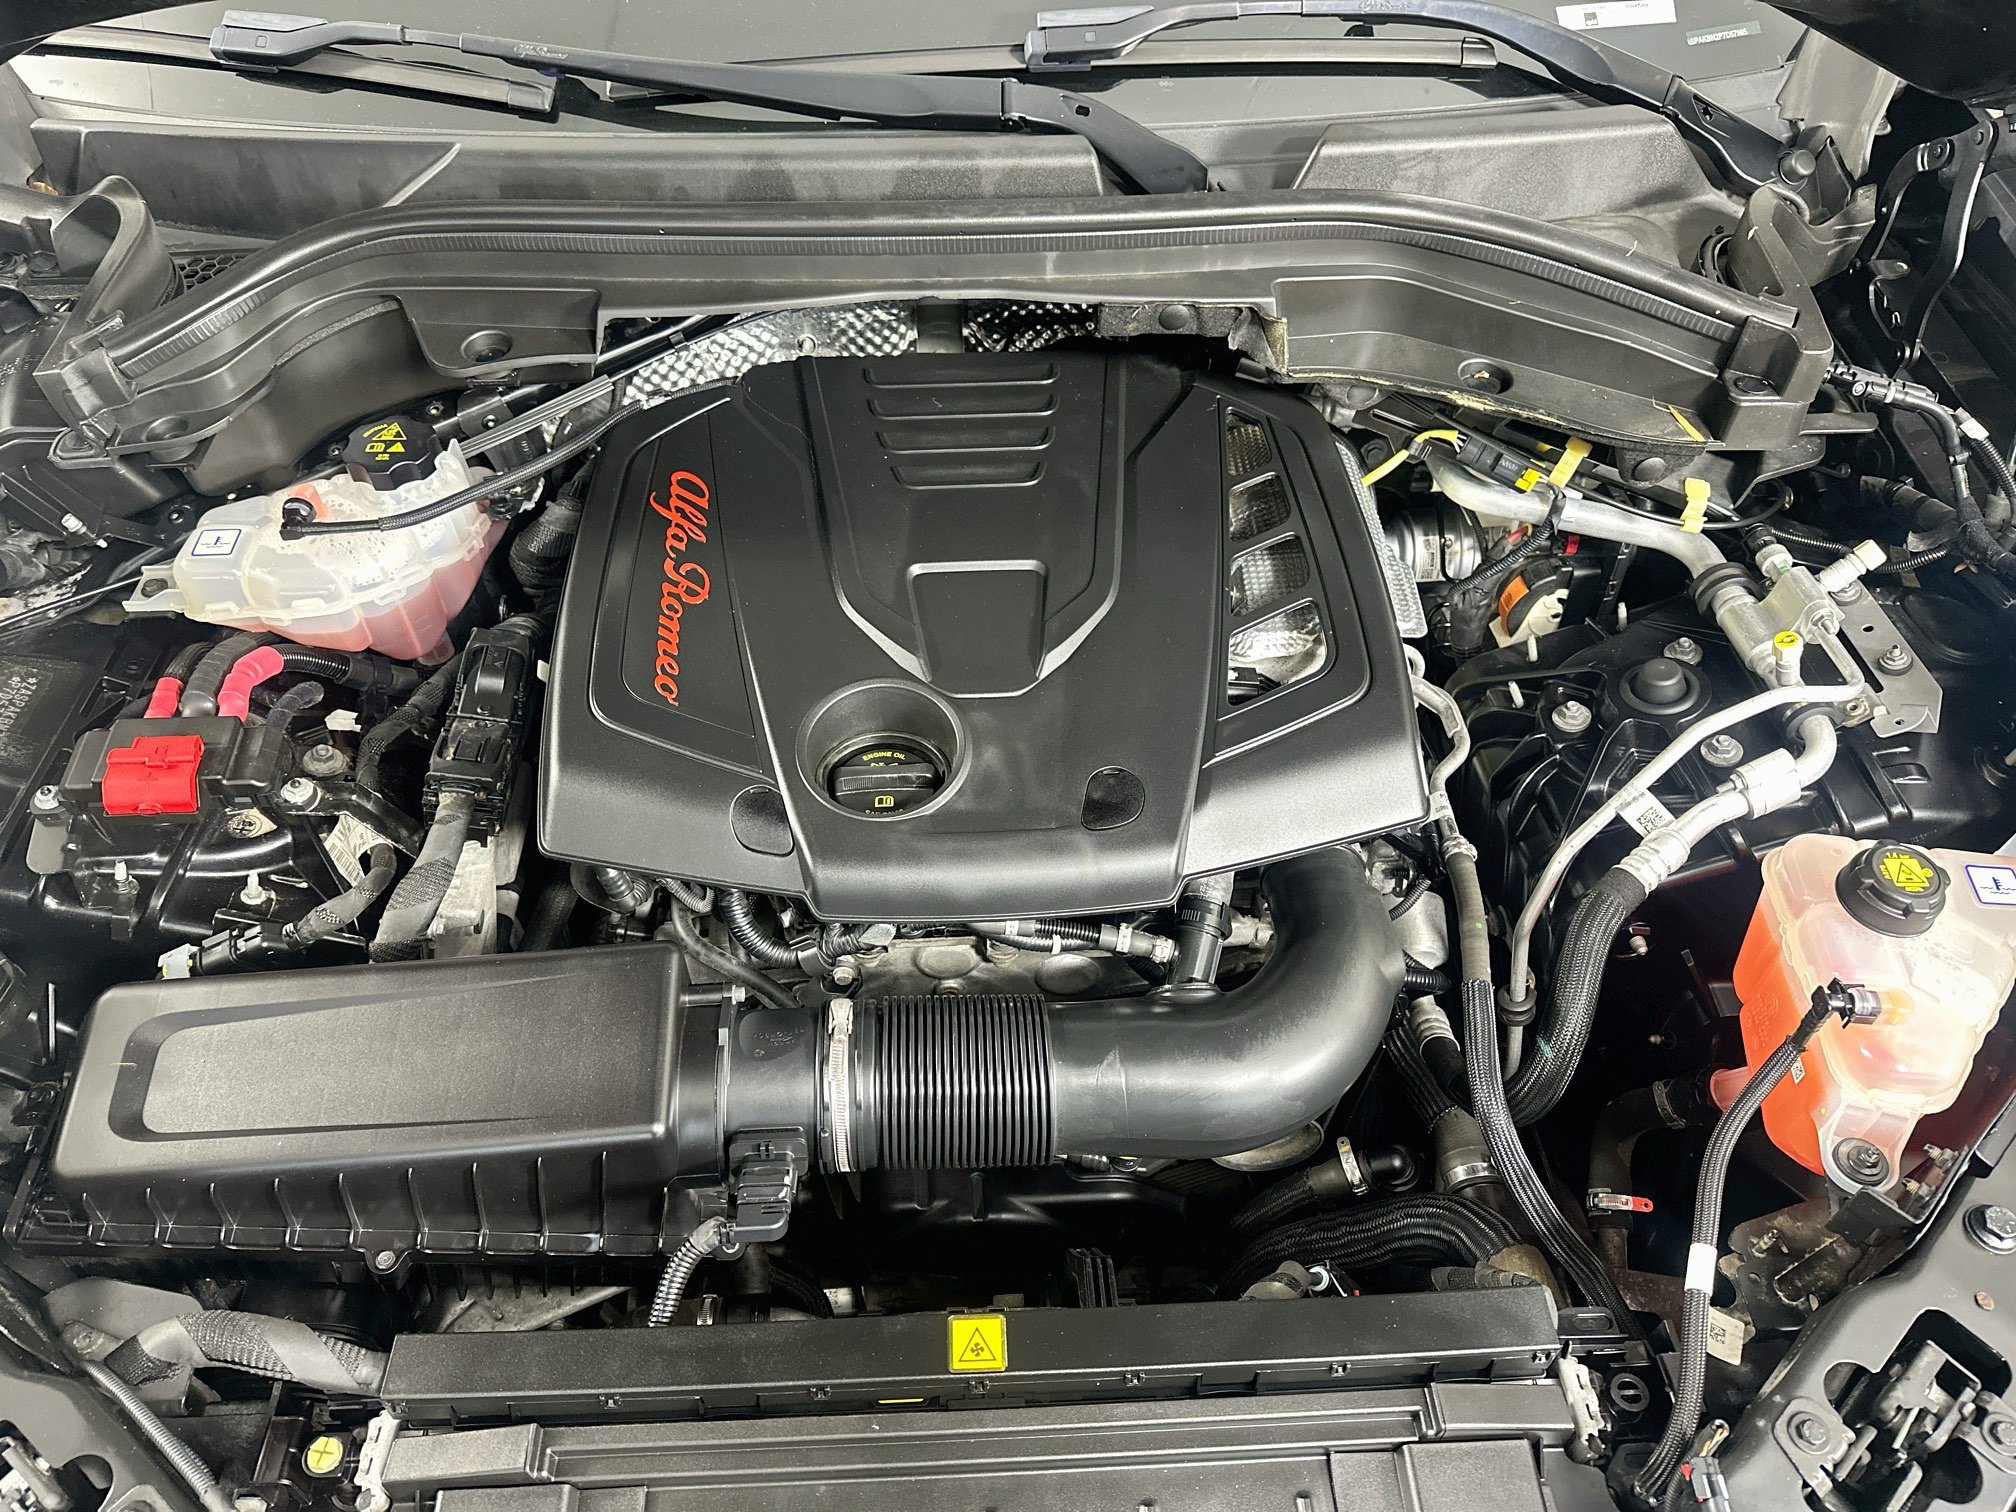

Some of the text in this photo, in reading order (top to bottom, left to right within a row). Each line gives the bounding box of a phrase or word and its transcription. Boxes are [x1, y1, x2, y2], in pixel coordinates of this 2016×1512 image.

[650, 470, 711, 706] Alfa Romeo
[862, 752, 905, 762] ENGINE OIL
